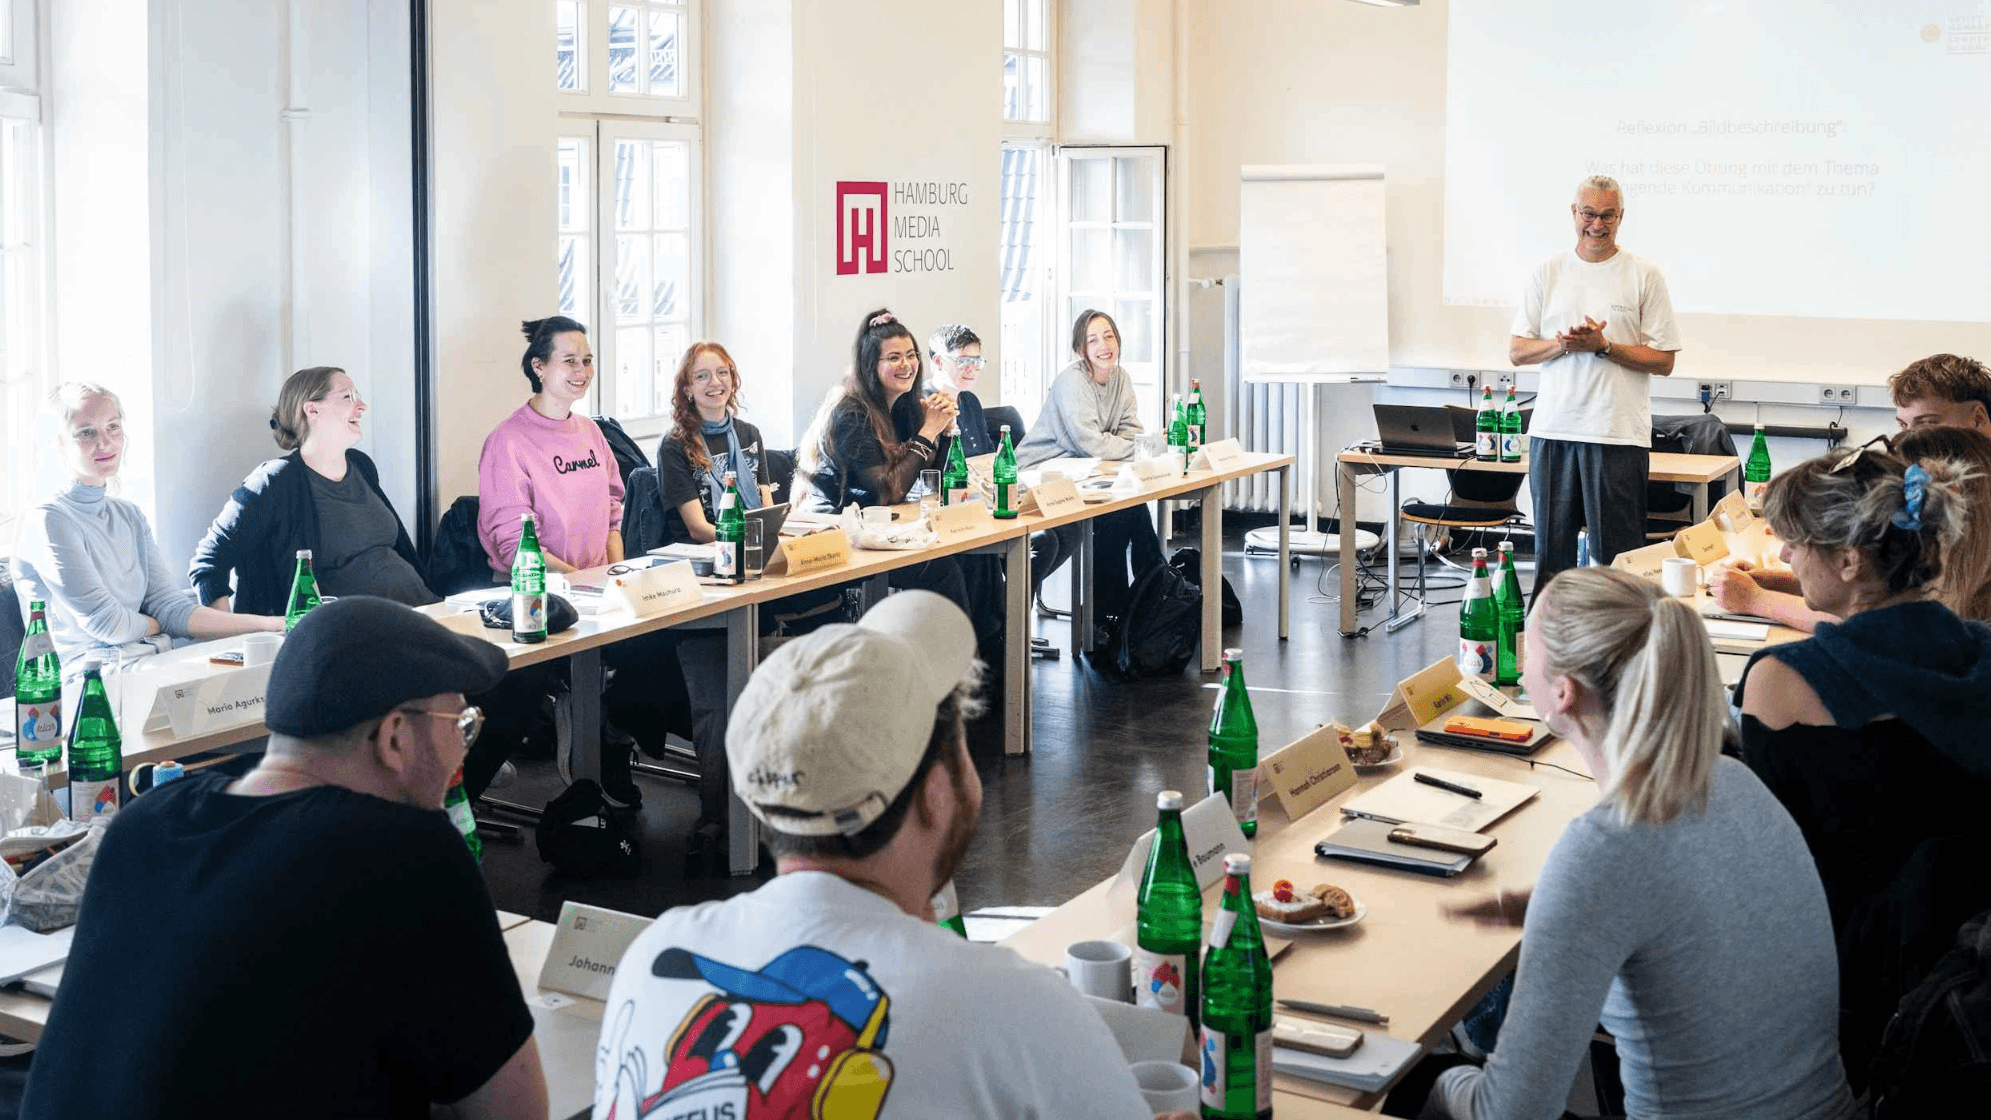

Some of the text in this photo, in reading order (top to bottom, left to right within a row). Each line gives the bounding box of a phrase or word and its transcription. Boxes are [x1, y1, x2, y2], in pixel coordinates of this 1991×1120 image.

[1584, 157, 1880, 179] Was hat diese Übung mit dem Thema
[894, 182, 968, 205] HAMBURG
[1816, 184, 1836, 196] zu
[1840, 180, 1876, 197] tun?
[894, 215, 941, 238] MEDIA
[894, 248, 954, 273] SCHOOL
